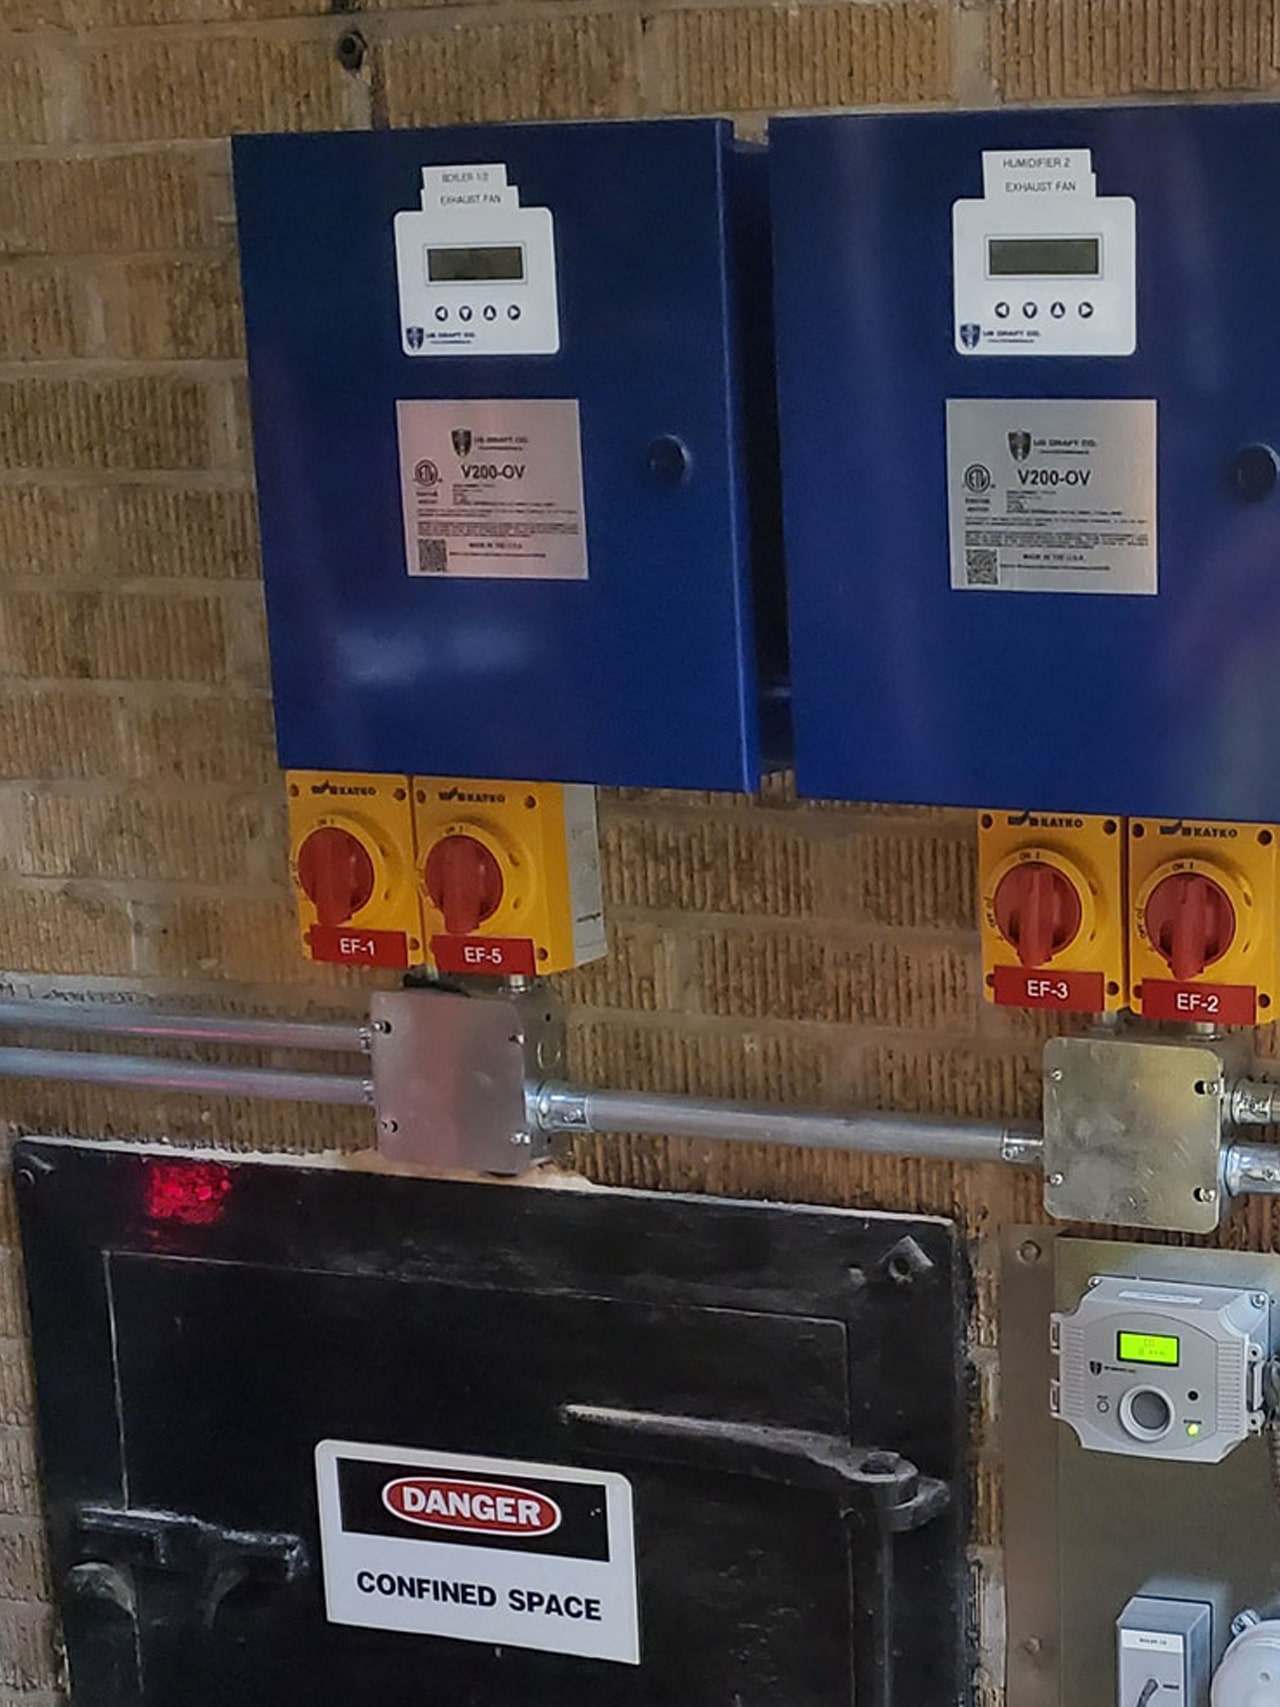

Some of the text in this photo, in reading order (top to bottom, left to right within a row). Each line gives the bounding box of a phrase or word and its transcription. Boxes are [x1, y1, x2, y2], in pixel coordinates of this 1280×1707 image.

[1003, 157, 1071, 168] HUMIDIFIER 2
[441, 172, 474, 184] BOILER
[1005, 181, 1076, 193] EXHAUST FAN
[440, 193, 502, 206] EXHAUST FAN
[1050, 439, 1080, 447] DRAFT
[461, 464, 526, 480] V200-OV
[1017, 469, 1091, 486] V200-OV
[1041, 818, 1083, 828] KATKO
[1194, 827, 1238, 838] KATKO
[339, 937, 376, 956] EF-1
[464, 947, 503, 964] EF-5
[1027, 979, 1069, 999] EF-3
[1176, 993, 1220, 1012] EF-2
[402, 1485, 542, 1526] DANGER
[356, 1571, 602, 1621] CONFINED SPACE
